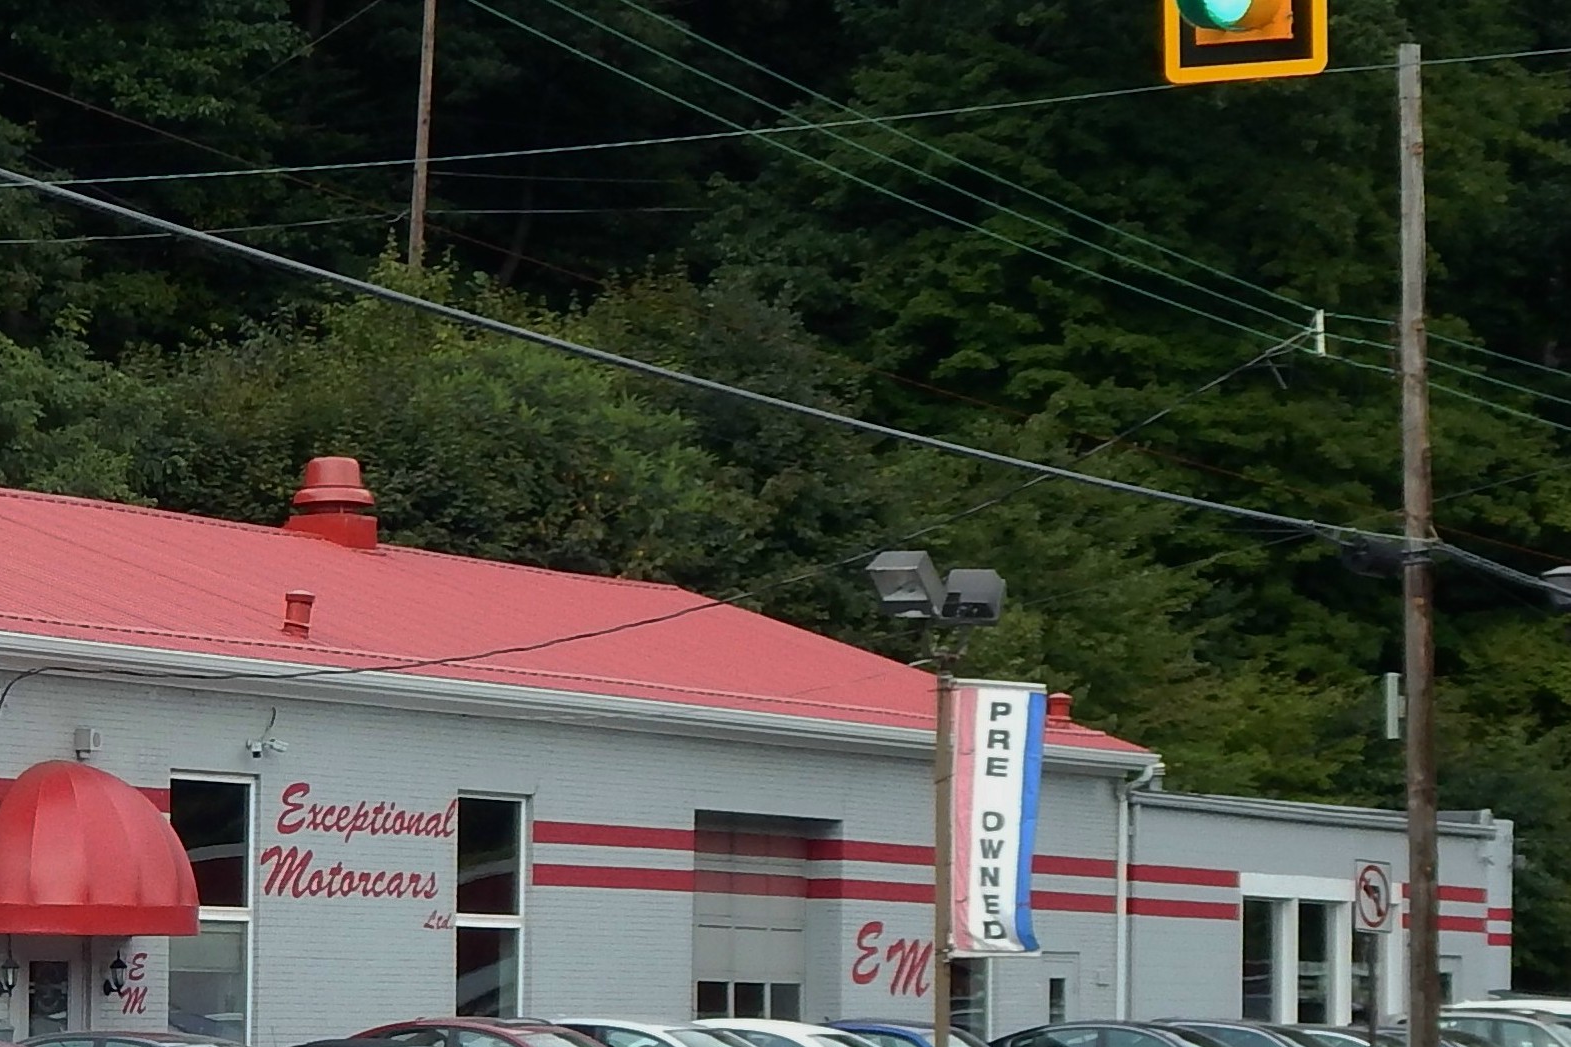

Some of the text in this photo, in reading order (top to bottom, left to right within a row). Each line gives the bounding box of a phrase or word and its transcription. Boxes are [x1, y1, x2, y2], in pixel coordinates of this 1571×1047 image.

[277, 782, 458, 843] Exceptional
[980, 701, 1012, 940] PRE OWNED
[261, 845, 439, 899] Motorcars
